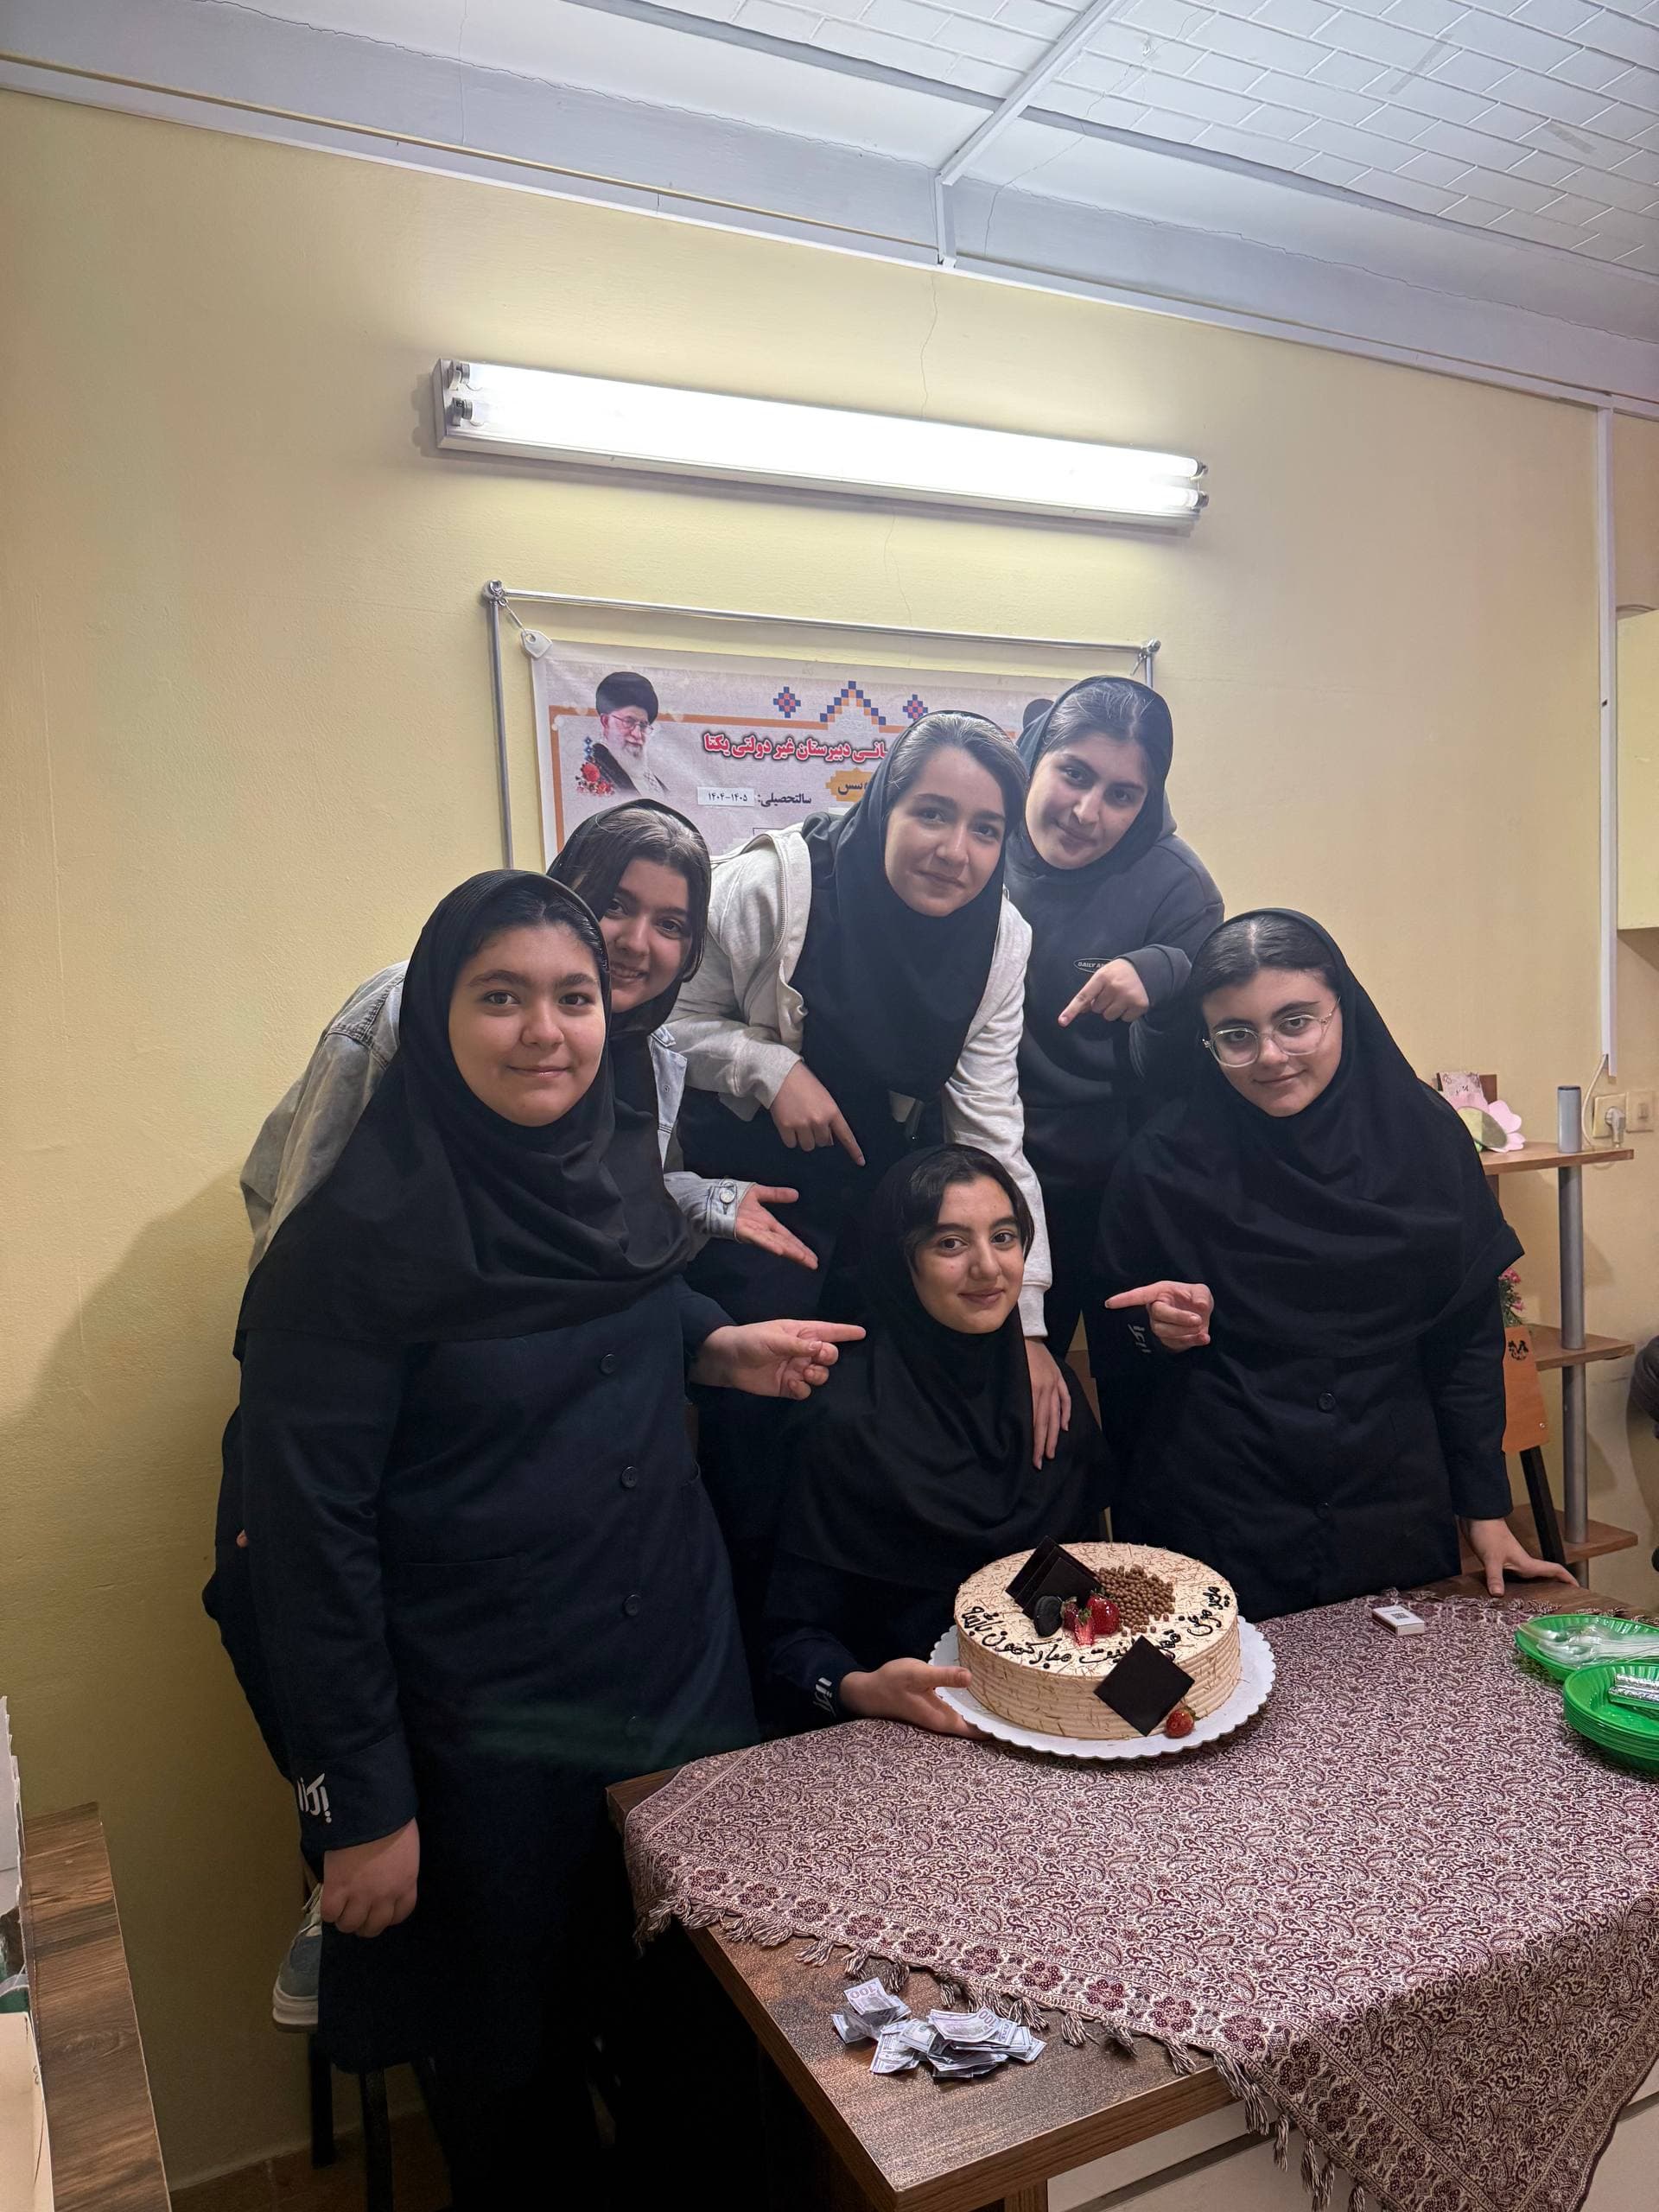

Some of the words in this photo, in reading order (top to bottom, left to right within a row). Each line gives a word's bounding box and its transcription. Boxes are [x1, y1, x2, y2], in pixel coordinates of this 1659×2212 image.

[703, 733, 730, 756] یکتا
[732, 734, 772, 759] دولتی
[772, 737, 795, 760] غیر
[796, 738, 851, 761] دبیرستان
[962, 1606, 1005, 1637] باشه
